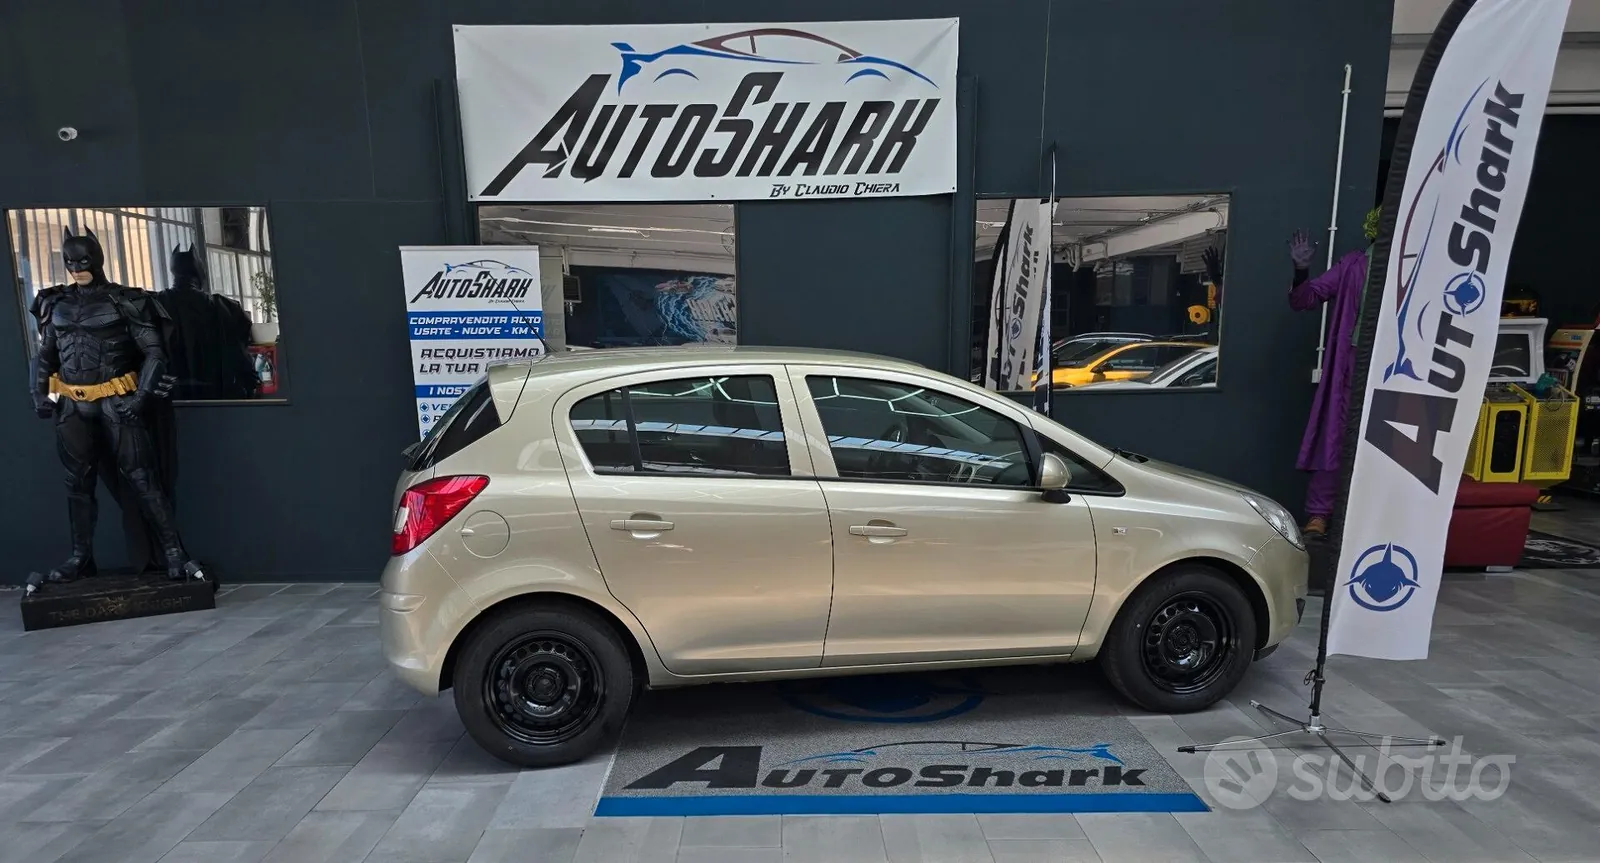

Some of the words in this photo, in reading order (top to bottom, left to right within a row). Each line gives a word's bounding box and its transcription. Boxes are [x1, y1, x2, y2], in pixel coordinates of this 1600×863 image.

[770, 184, 791, 198] BY
[794, 184, 850, 197] CLAUDIO
[853, 182, 901, 196] CHIERA
[409, 316, 508, 325] COMPRAVENDITA
[511, 316, 542, 325] AUTO
[413, 327, 452, 336] USATE
[461, 327, 502, 335] NUOVE
[511, 327, 529, 335] KM
[420, 348, 540, 359] ACQUISTIAMO
[419, 363, 441, 373] LA
[445, 363, 480, 373] TUA
[429, 386, 434, 396] I
